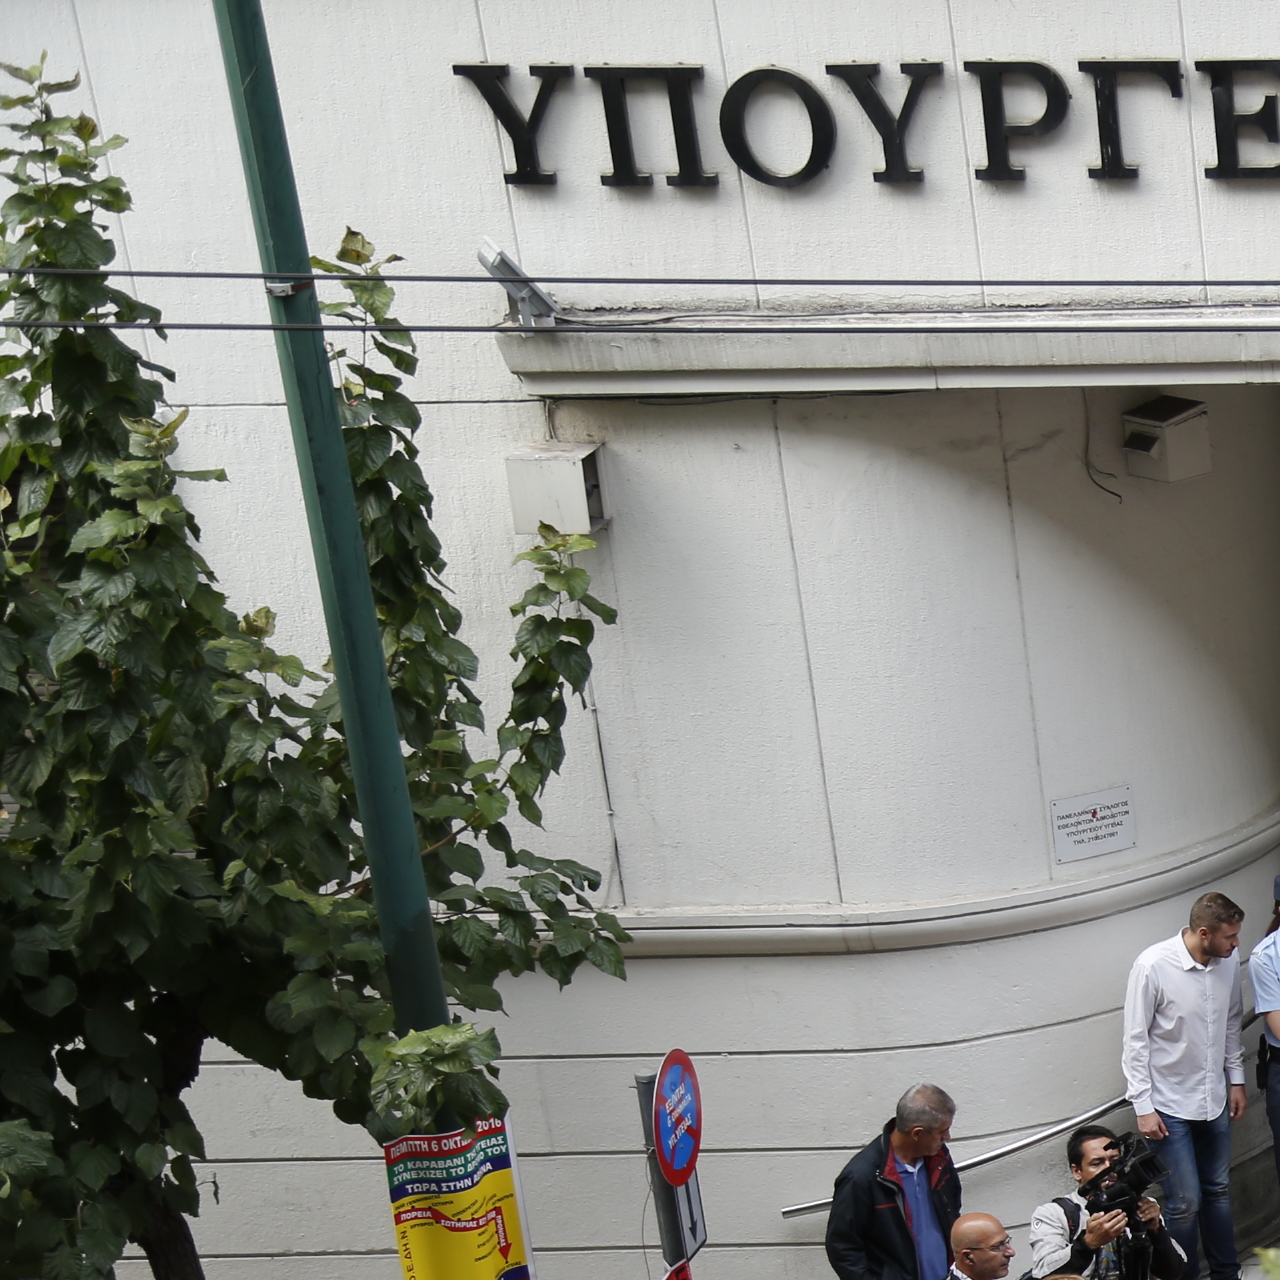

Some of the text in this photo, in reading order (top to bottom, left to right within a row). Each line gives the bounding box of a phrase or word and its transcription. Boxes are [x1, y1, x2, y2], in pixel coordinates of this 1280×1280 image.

[390, 1140, 429, 1160] ΠΕΜΠΤΗ
[431, 1140, 440, 1152] 6
[476, 1117, 502, 1133] 2016
[393, 1170, 447, 1186] ΣΥΝΕΧΙΖΕΙ
[449, 1166, 465, 1177] ΤΟ
[485, 1144, 508, 1157] ΤΟΥ
[393, 1163, 404, 1175] ΤΟ
[407, 1156, 465, 1170] ΚΑΡΑΒΑΝΙ
[405, 1182, 439, 1194] ΤΩΡΑ
[440, 1177, 472, 1192] ΣΤΗΝ
[400, 1210, 433, 1221] ΠΟΡΕΙΑ
[440, 1218, 478, 1229] ΣΩΤΗΡΙΑΣ
